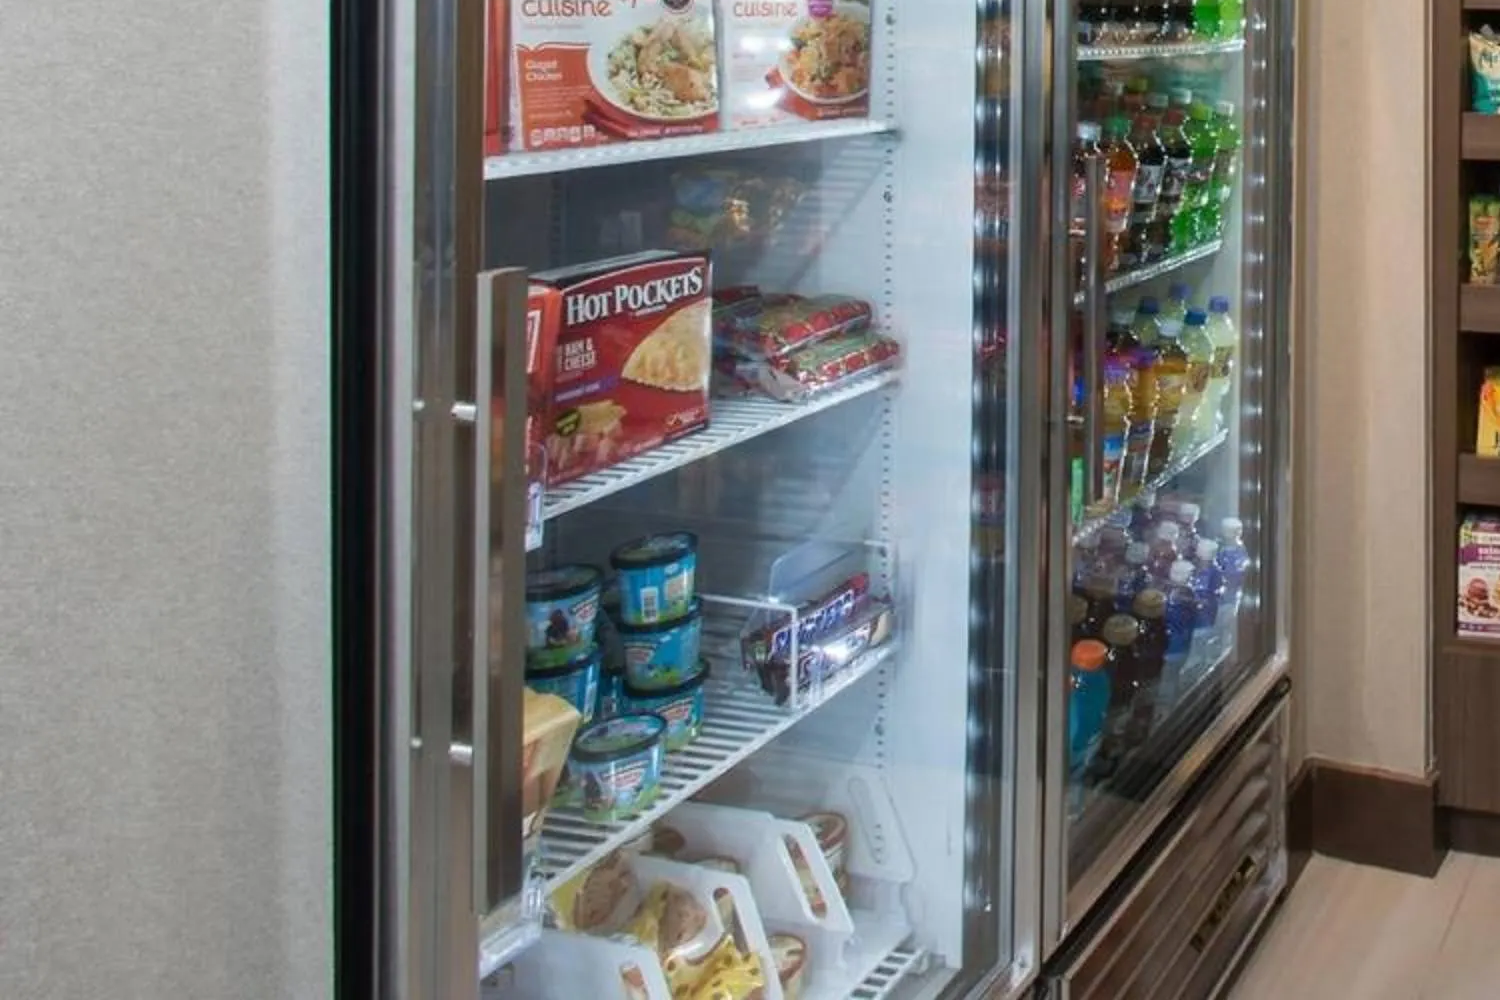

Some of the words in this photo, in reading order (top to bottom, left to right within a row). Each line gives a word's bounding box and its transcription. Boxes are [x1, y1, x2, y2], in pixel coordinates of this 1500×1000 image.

[733, 0, 798, 18] cuisine
[566, 292, 612, 326] HOT
[614, 266, 704, 314] POCKETS
